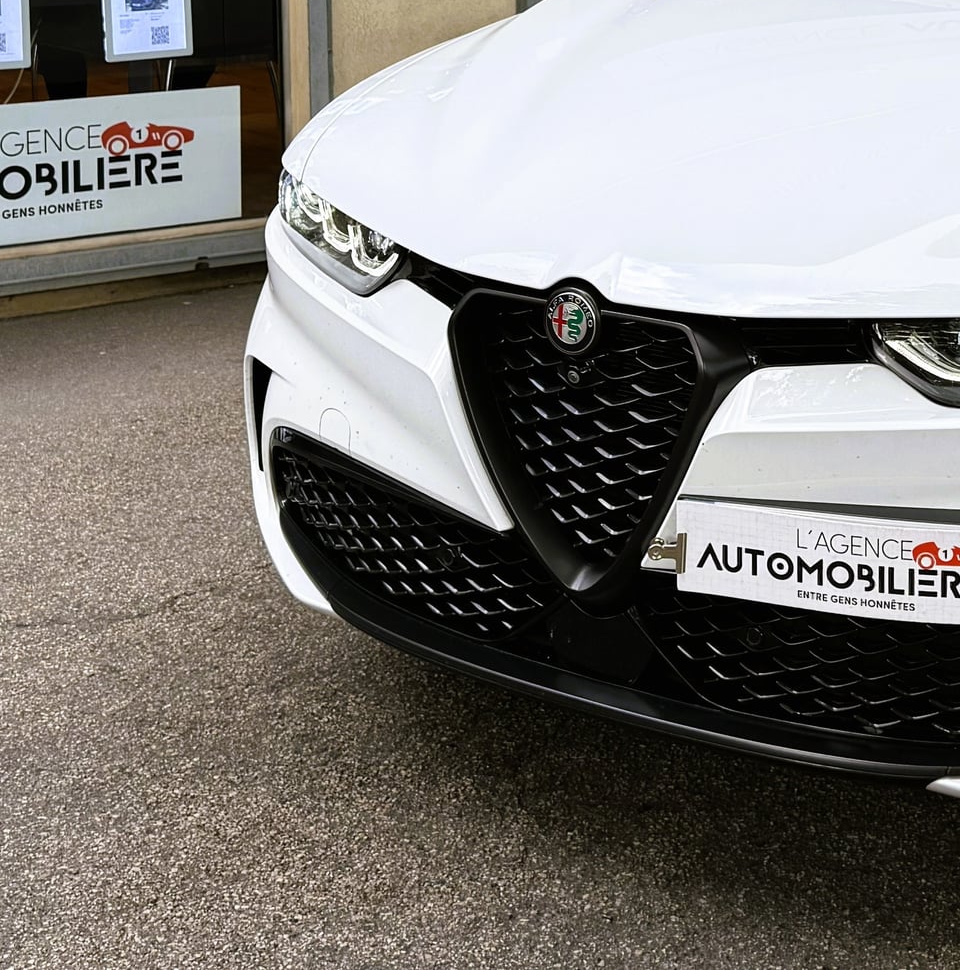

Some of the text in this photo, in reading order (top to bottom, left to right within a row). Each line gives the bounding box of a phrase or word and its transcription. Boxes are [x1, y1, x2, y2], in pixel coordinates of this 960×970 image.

[135, 129, 143, 141] 1
[2, 199, 104, 221] GENS HONNÊTES
[796, 527, 914, 562] L'AGENCE
[796, 590, 916, 612] ENTRE GENS HONNÊTES
